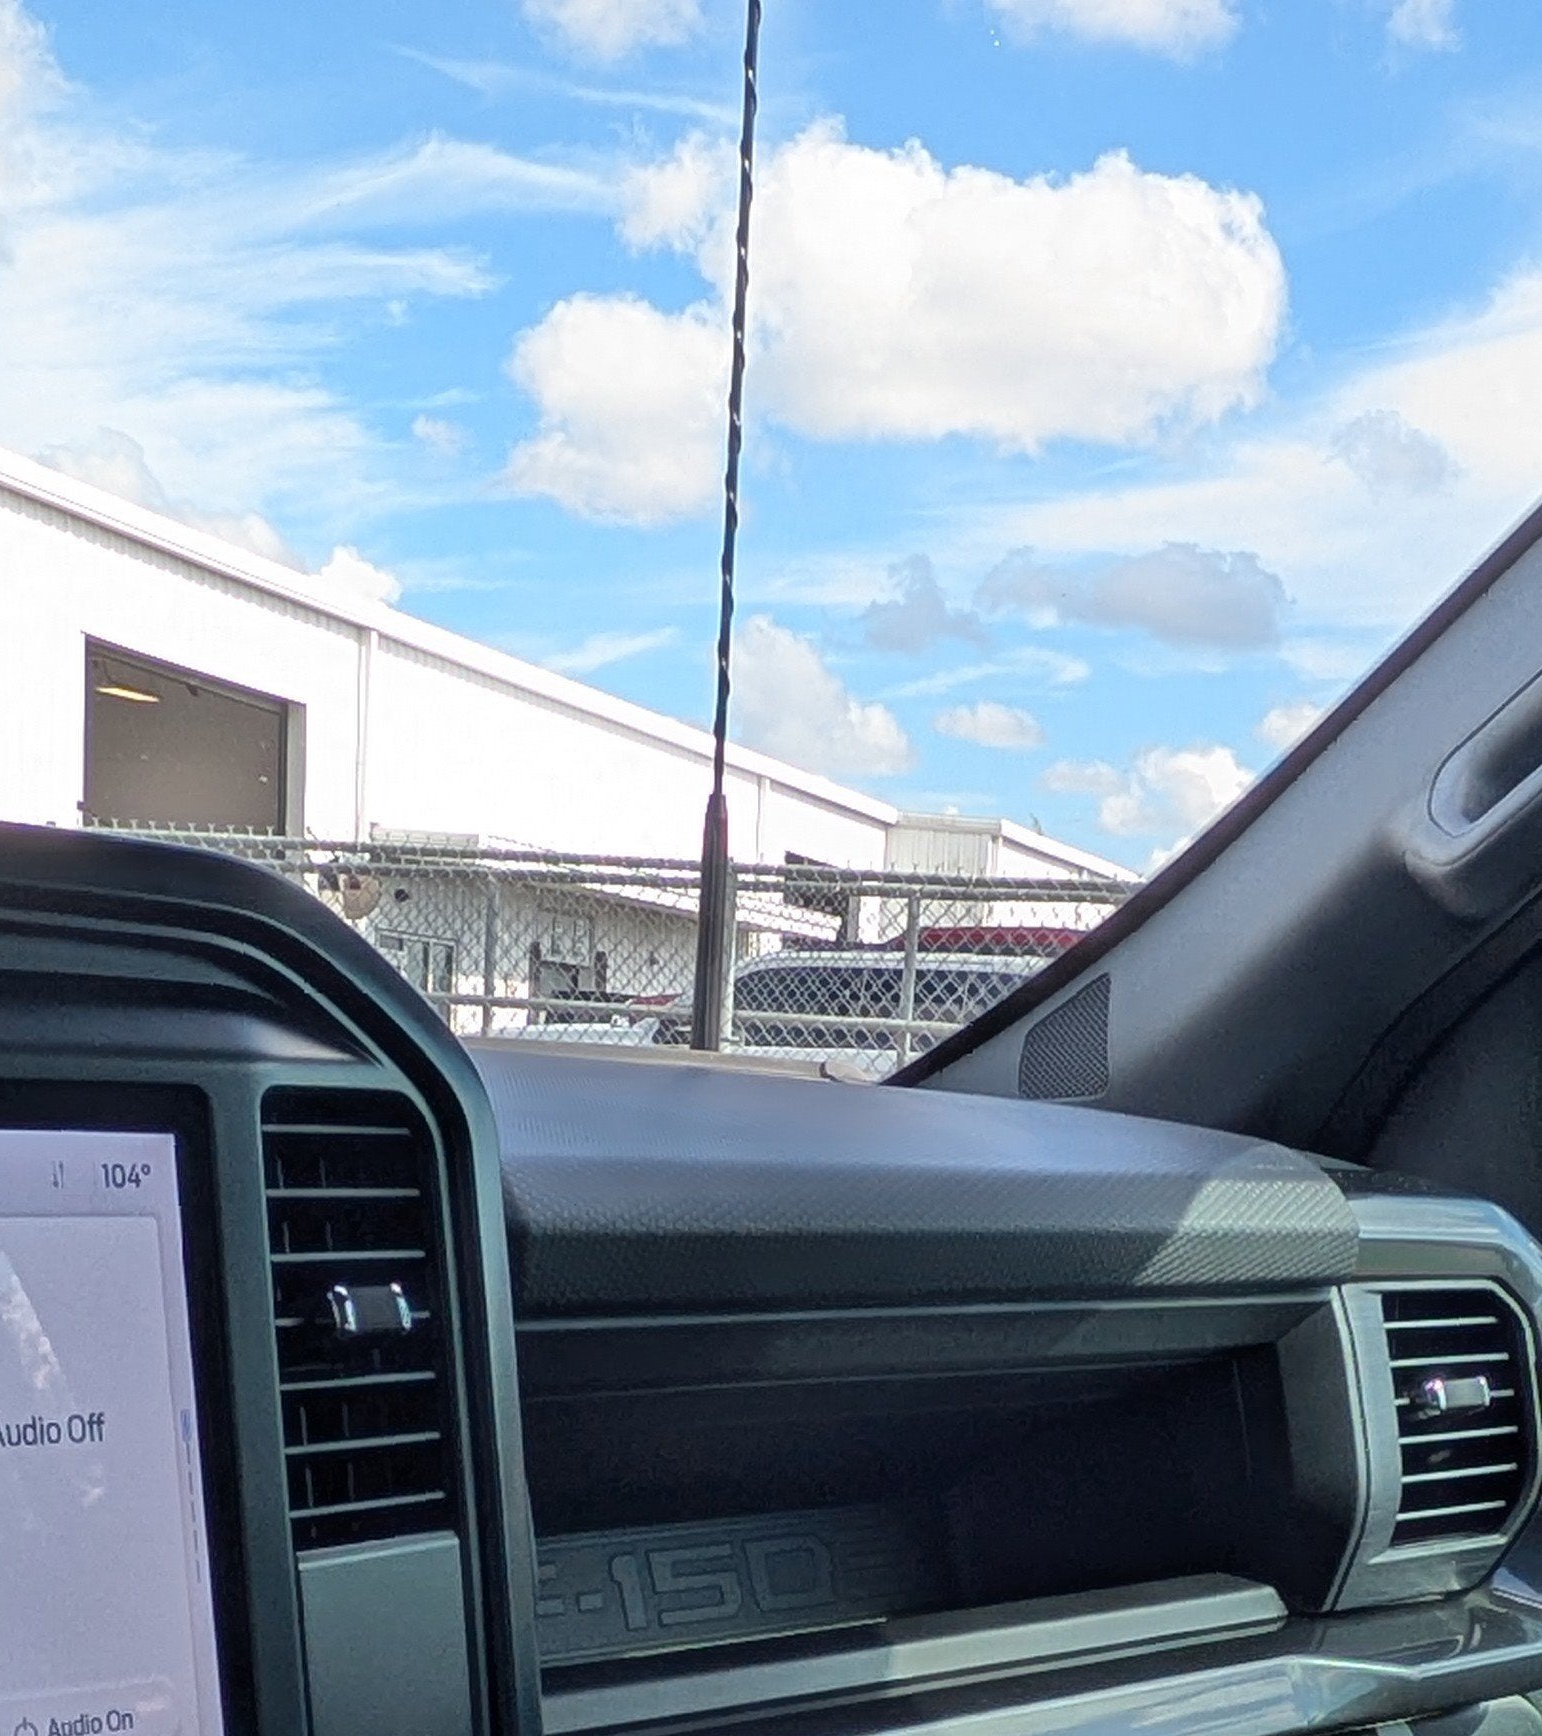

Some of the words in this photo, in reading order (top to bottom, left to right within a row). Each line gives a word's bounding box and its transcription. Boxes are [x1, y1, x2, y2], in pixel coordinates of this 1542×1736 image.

[101, 1162, 151, 1189] 104°
[67, 1412, 105, 1443] Off
[106, 1709, 134, 1733] On
